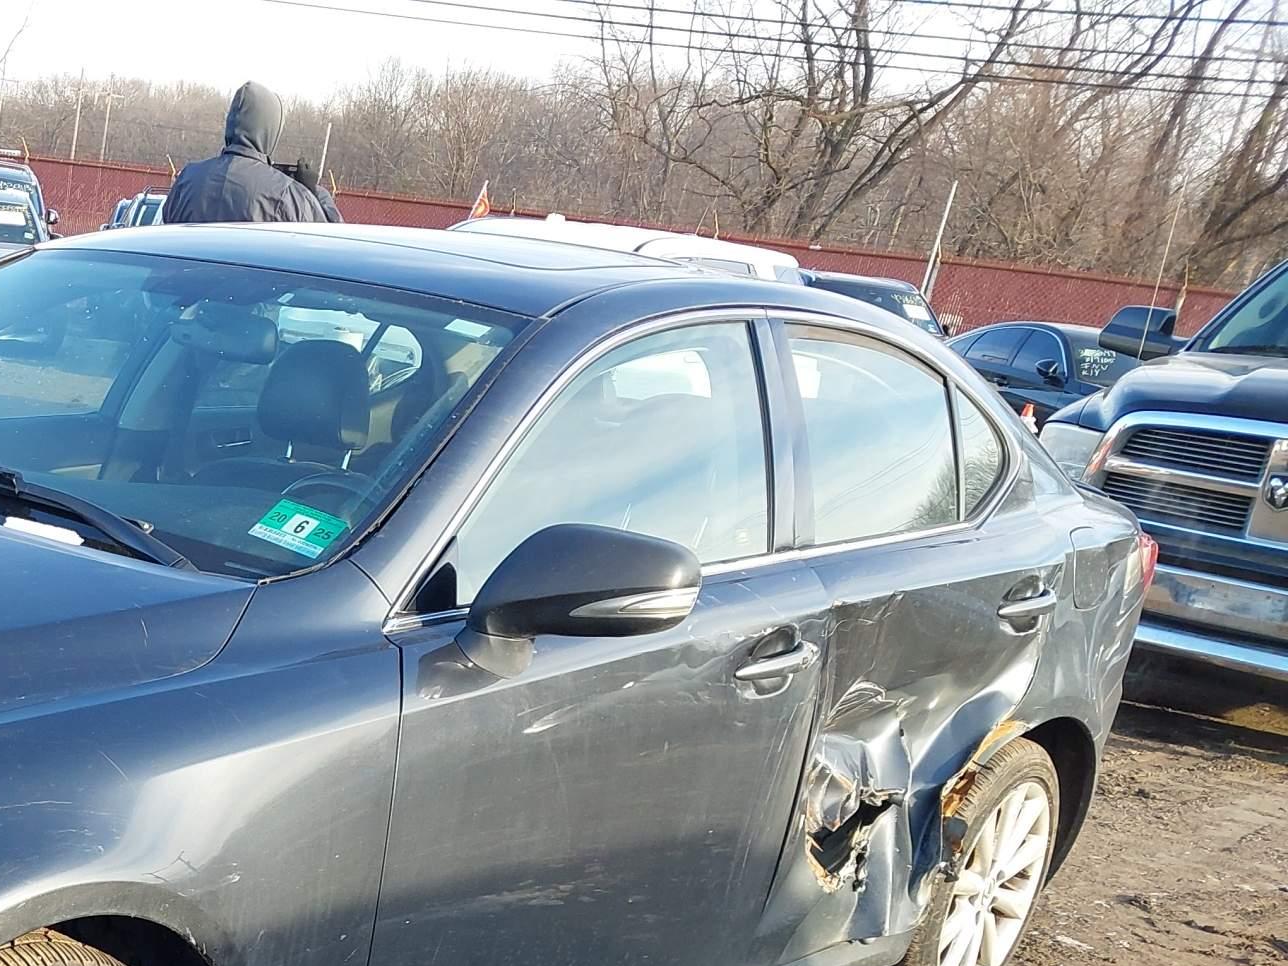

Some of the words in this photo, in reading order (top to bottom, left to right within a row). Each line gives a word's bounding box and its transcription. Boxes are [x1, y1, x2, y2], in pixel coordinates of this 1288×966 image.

[270, 511, 288, 523] 20
[293, 520, 310, 534] 6
[313, 528, 334, 541] 25
